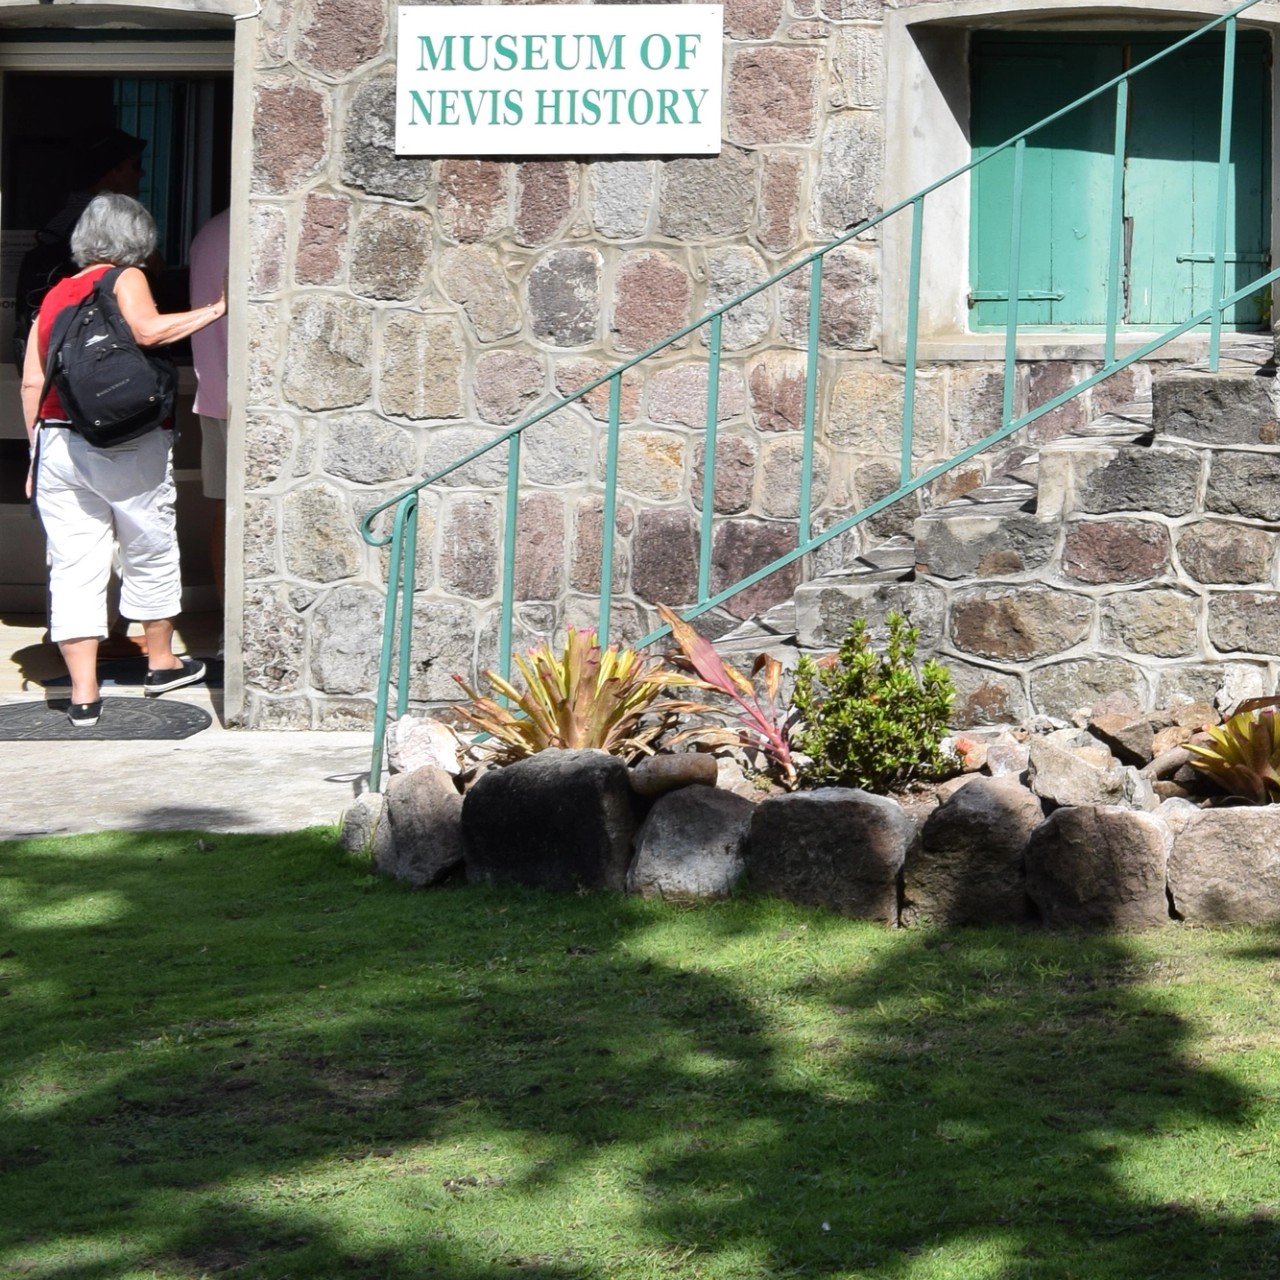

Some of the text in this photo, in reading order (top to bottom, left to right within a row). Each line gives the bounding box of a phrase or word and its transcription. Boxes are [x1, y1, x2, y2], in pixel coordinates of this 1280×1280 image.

[416, 33, 701, 72] MUSEUM OF
[408, 88, 709, 126] NEVIS HISTORY
